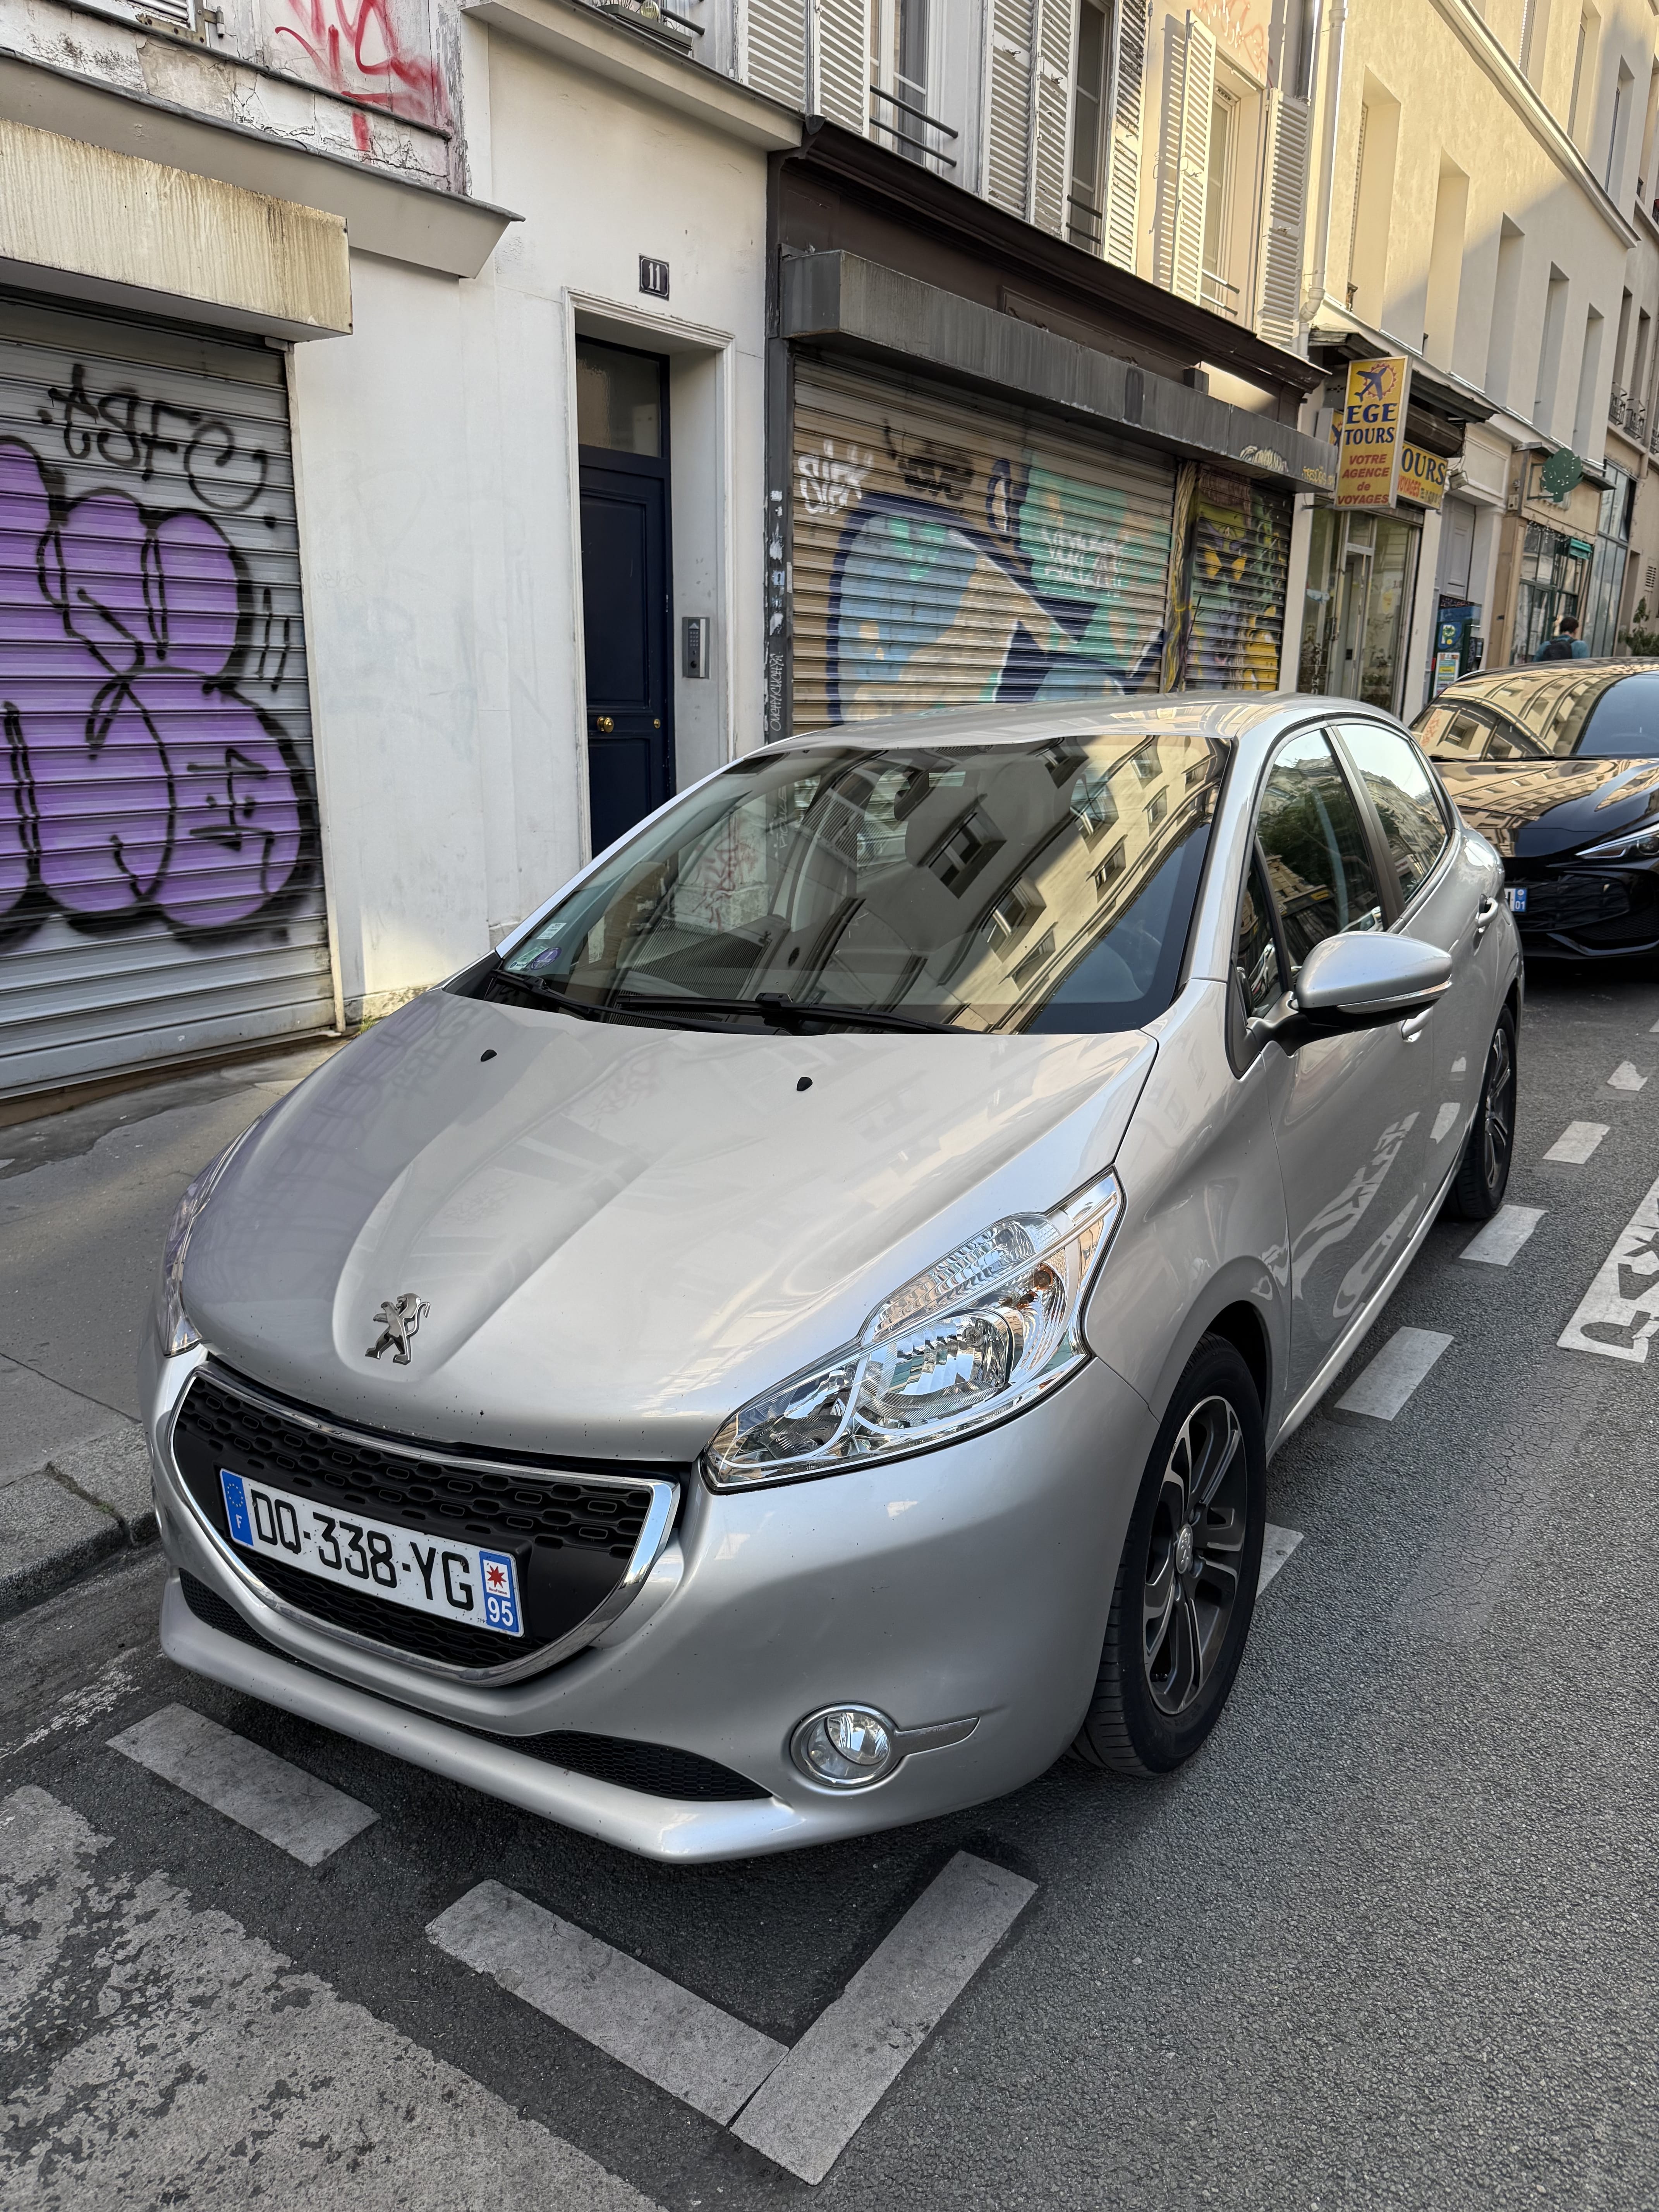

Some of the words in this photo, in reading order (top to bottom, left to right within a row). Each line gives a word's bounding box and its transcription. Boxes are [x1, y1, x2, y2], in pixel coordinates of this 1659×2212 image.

[648, 263, 660, 291] 11
[1347, 403, 1398, 424] EGE
[1344, 427, 1395, 445] TOURS
[1350, 454, 1387, 465] VOTRE
[1401, 446, 1446, 485] OURS
[1342, 467, 1390, 478] AGENCE
[1357, 481, 1371, 491] de
[1338, 494, 1389, 505] VOYAGES
[1515, 901, 1525, 910] 01
[235, 1513, 242, 1529] F
[251, 1489, 474, 1611] DQ-338-YG
[488, 1597, 514, 1626] 95
